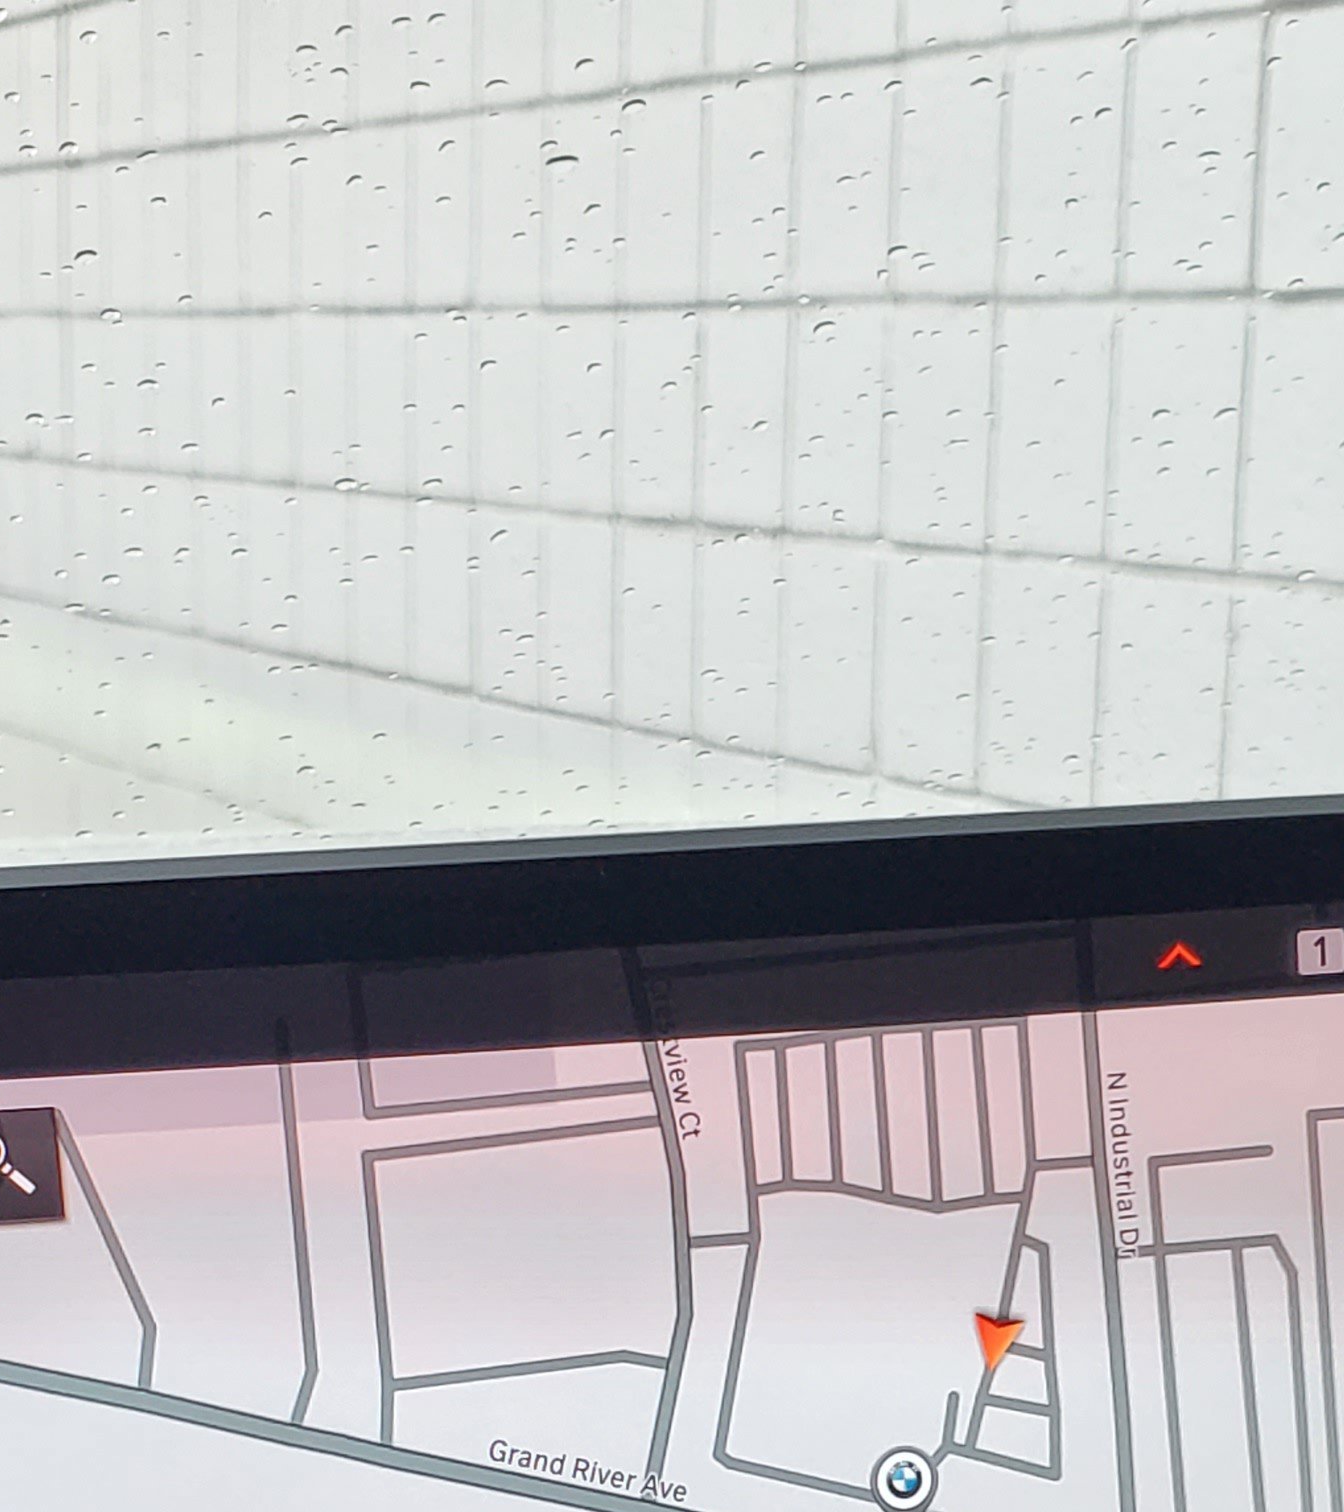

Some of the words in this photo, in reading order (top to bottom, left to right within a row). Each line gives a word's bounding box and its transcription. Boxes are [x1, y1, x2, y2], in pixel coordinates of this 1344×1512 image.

[1107, 1072, 1128, 1090] N
[678, 1112, 701, 1141] Ct
[1109, 1098, 1138, 1220] Industrial
[1119, 1228, 1140, 1259] Dr
[489, 1439, 567, 1476] Grand
[572, 1457, 637, 1491] River
[640, 1474, 688, 1502] Ave
